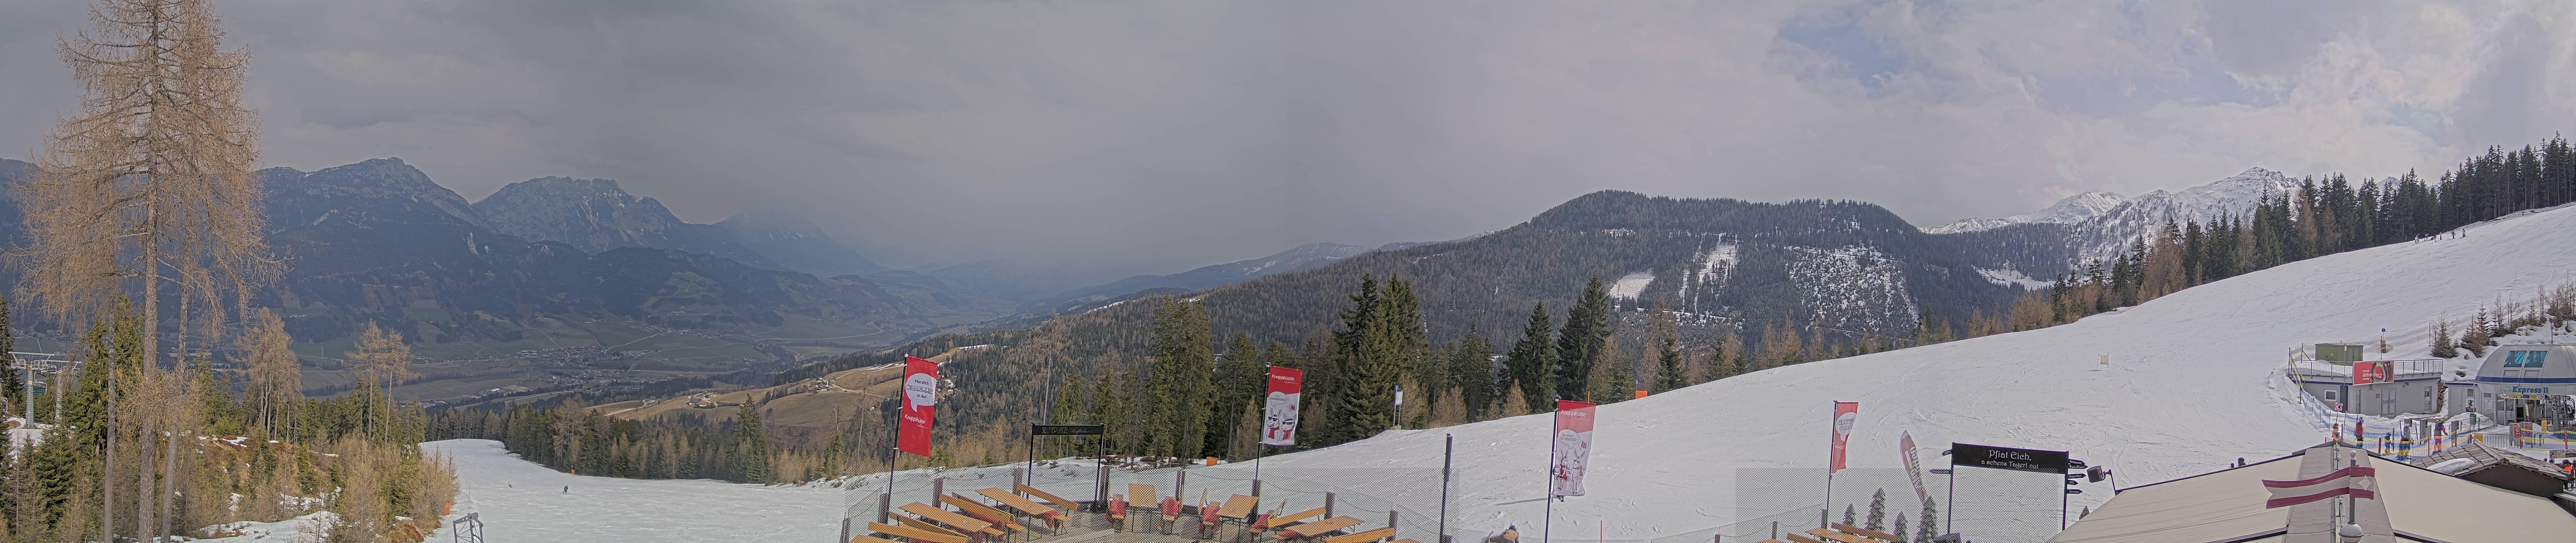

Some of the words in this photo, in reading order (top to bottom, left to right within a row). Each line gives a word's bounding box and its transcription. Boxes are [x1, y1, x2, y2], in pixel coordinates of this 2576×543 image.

[2373, 369, 2382, 379] Coca-Cola
[906, 384, 933, 394] WILLKOMMEN
[904, 414, 925, 424] Knapplhütte
[1988, 450, 2008, 459] Pfiat
[2011, 452, 2031, 461] Eich,
